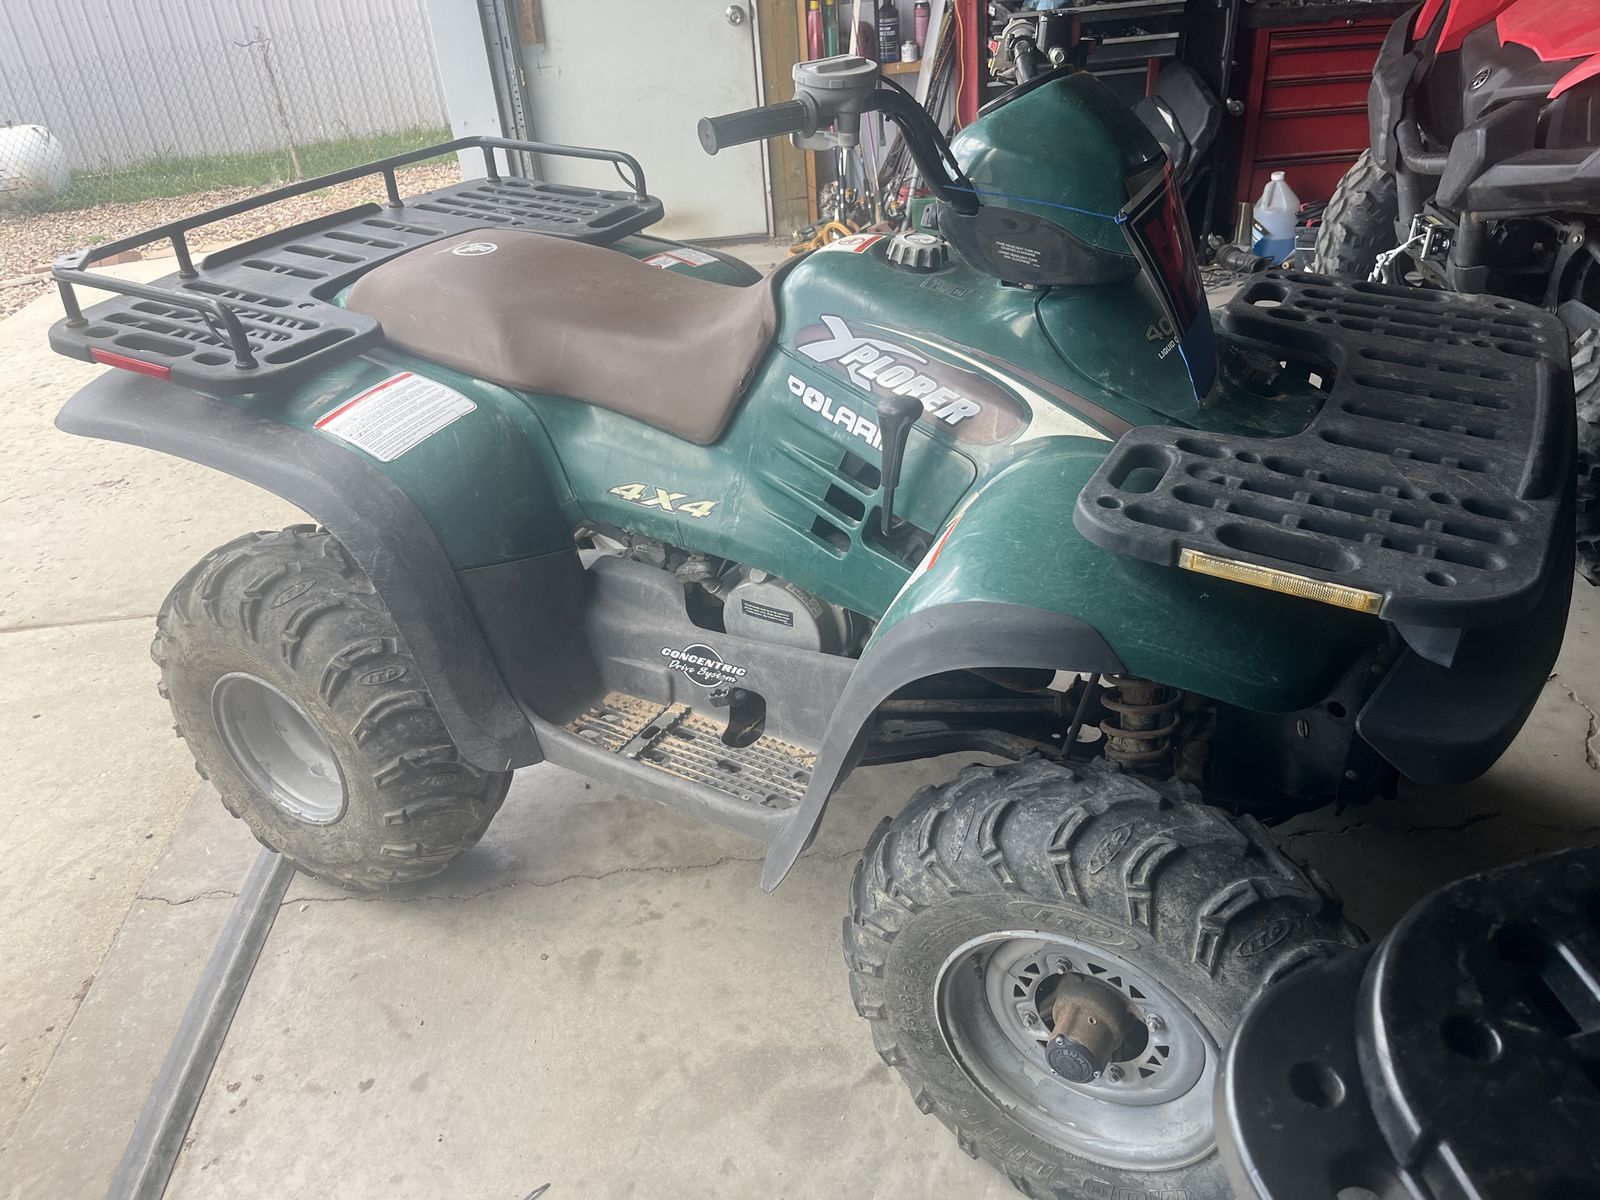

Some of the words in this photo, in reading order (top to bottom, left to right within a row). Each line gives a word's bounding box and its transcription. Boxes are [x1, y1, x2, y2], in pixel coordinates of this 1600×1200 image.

[1157, 339, 1176, 360] LIQUID
[797, 315, 981, 426] XPLORER
[787, 375, 884, 452] POLARI
[660, 647, 748, 677] CONCENTRIC
[668, 659, 696, 675] Drive
